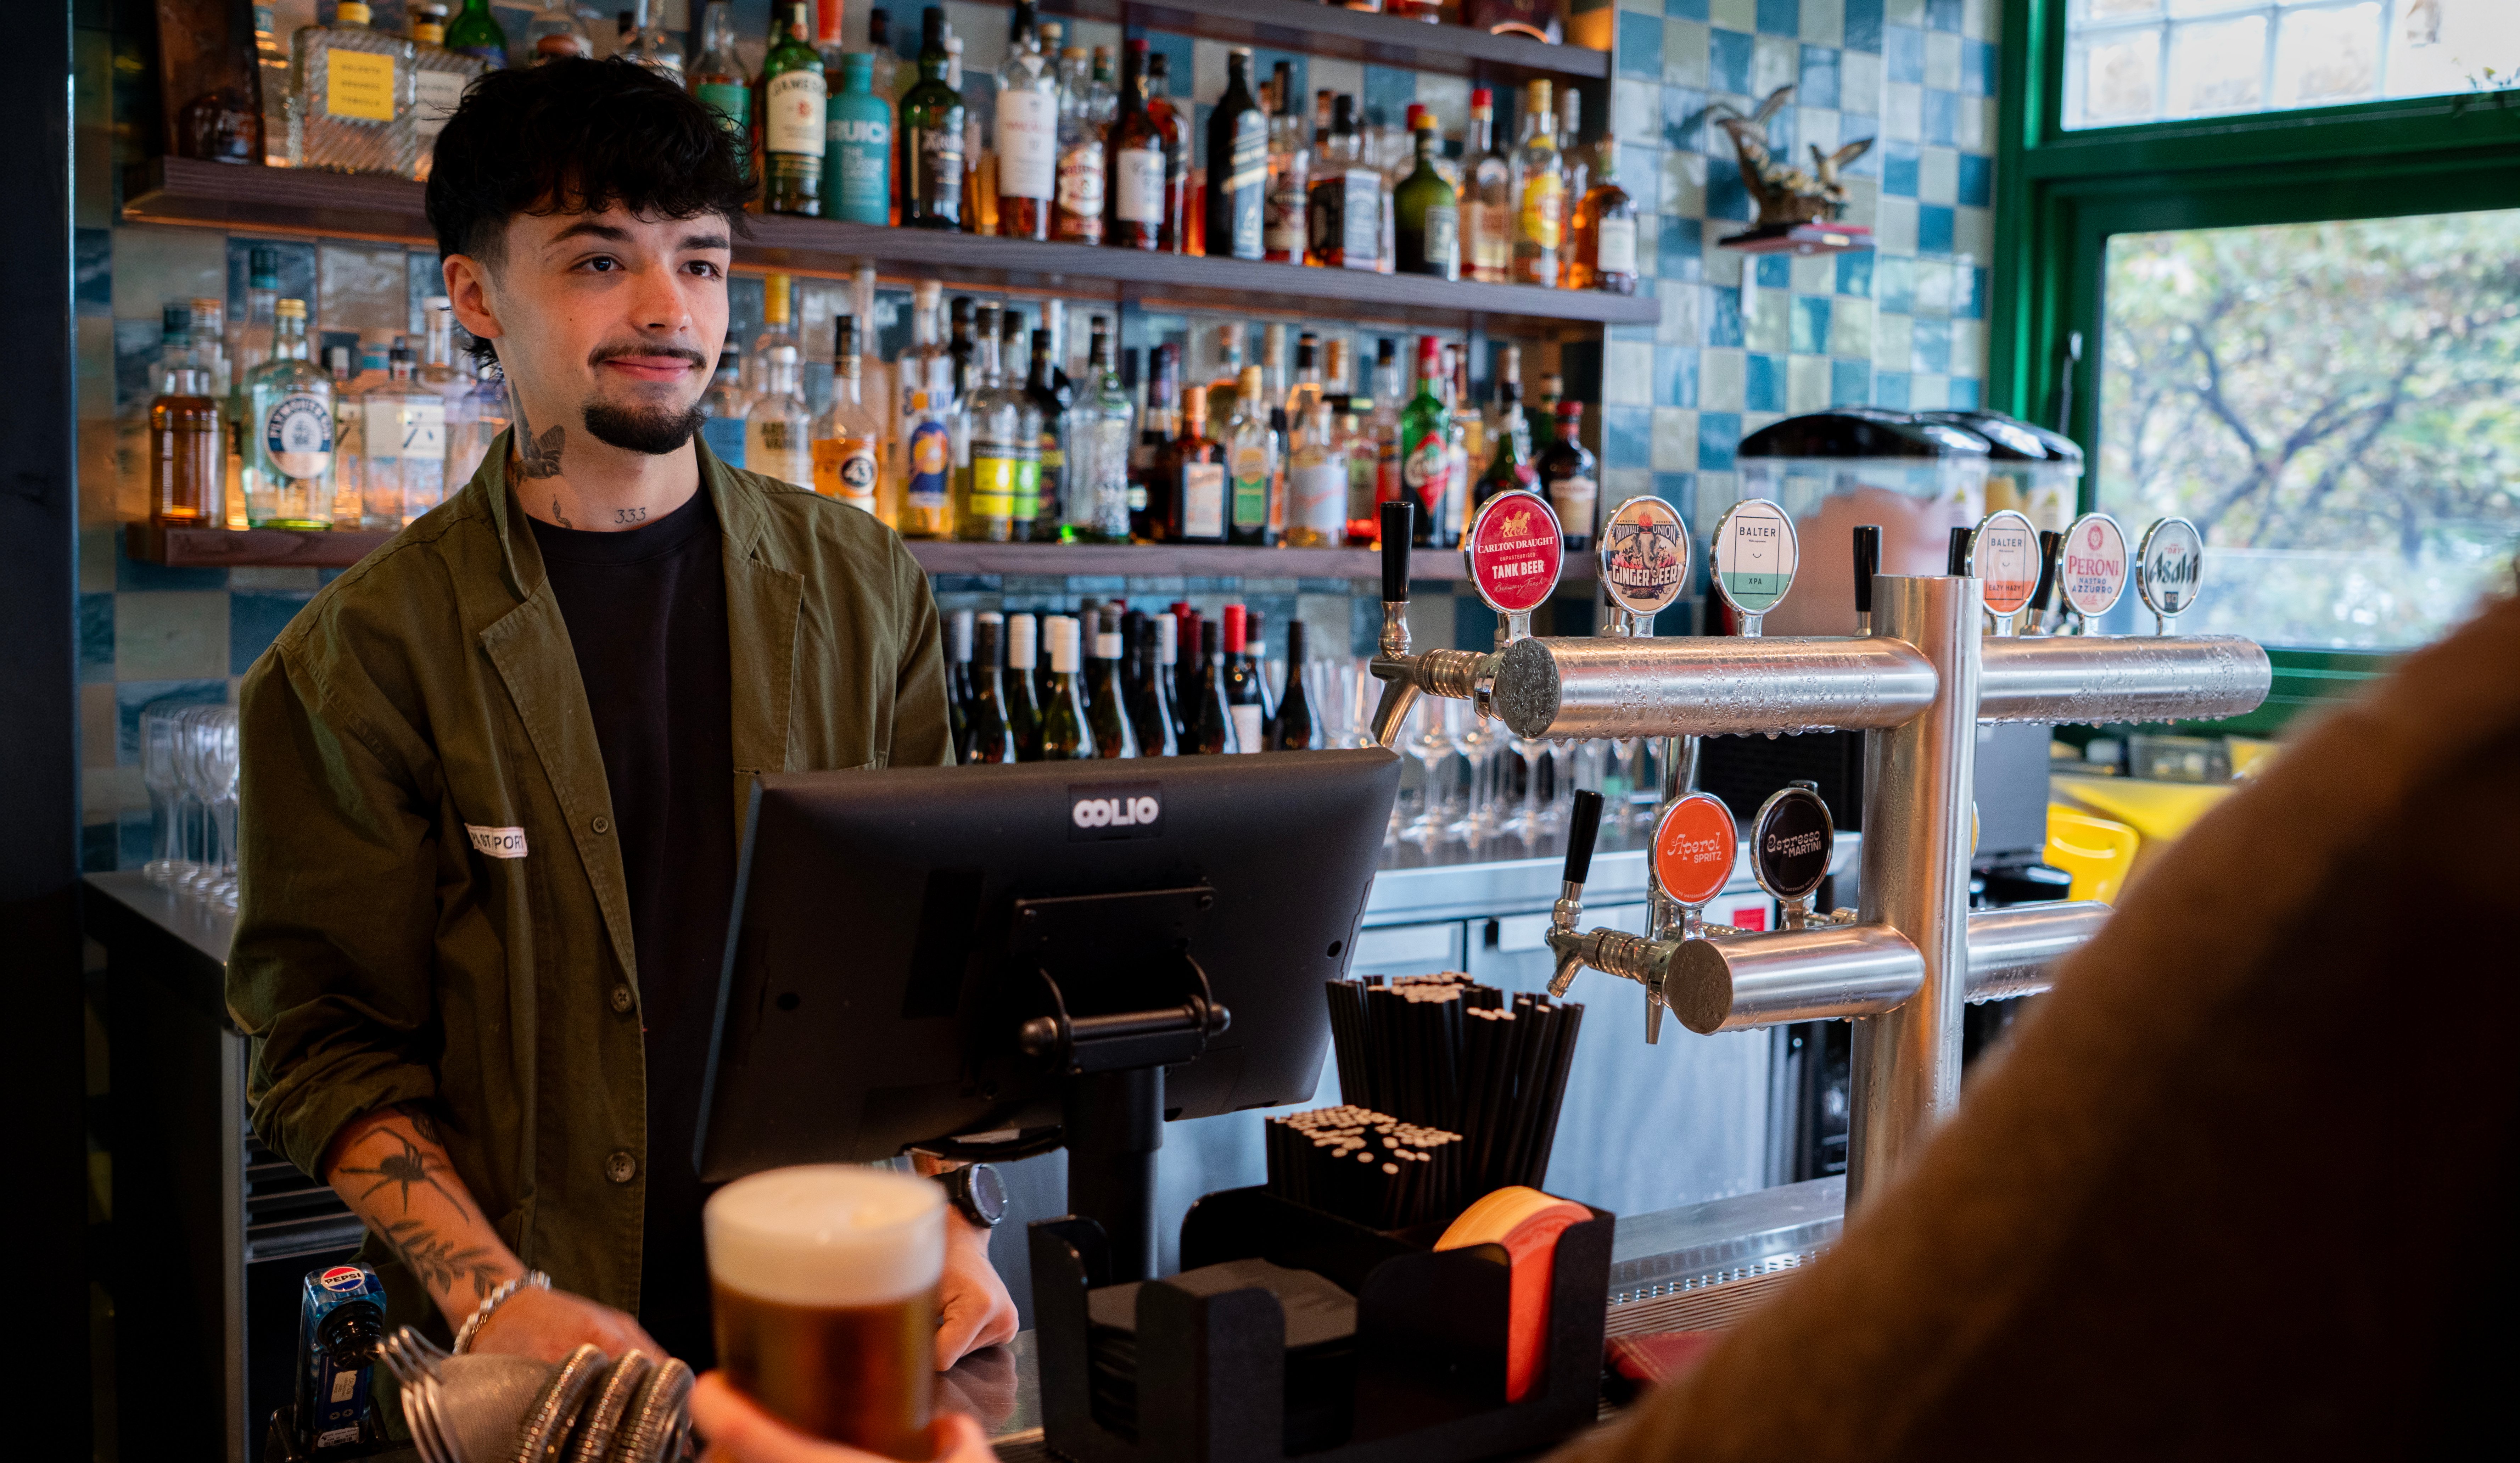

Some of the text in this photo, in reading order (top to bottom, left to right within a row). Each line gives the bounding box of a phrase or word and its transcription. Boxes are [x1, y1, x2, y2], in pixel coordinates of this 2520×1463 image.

[615, 507, 647, 524] 333
[1615, 523, 1676, 544] BROOKVALE UNION
[1740, 527, 1776, 537] BALTER
[1478, 536, 1554, 554] CARLTON DRAUGHT
[1991, 538, 2022, 547] BALTER
[1500, 553, 1536, 561] UNPASTEURISED
[1492, 560, 1544, 579] TANK BEER
[2068, 555, 2119, 577] PERONI
[2149, 552, 2199, 584] Asahi
[1612, 565, 1650, 586] GINGER
[2072, 585, 2113, 594] AZZURRO
[1667, 832, 1720, 861] Aperol
[1767, 830, 1820, 854] Espresso
[1788, 841, 1821, 858] MARTINI
[1694, 851, 1722, 864] SPRITZ
[324, 1273, 362, 1284] PEPSI
